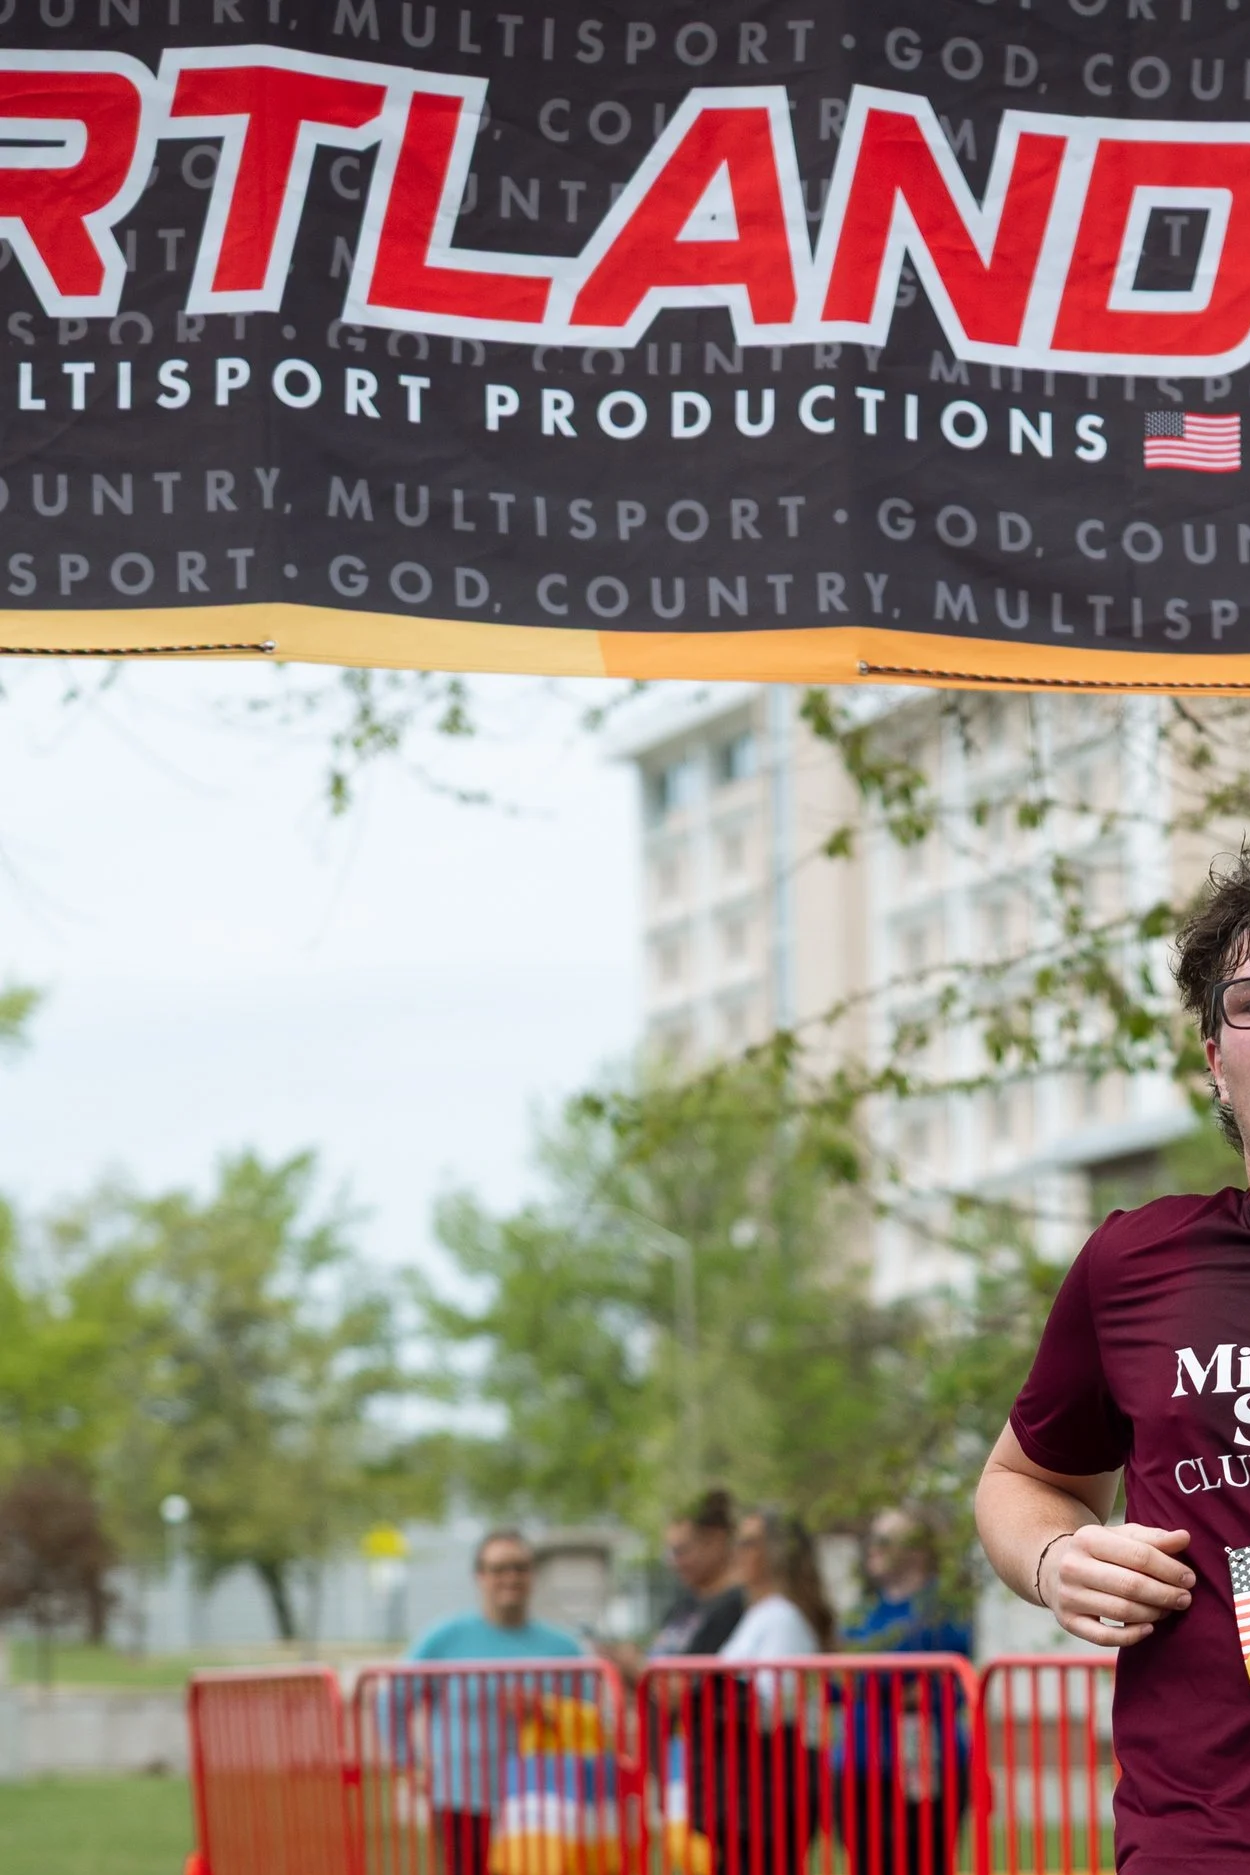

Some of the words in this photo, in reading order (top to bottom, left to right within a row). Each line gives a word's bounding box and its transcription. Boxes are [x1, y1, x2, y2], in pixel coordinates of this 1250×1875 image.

[333, 0, 815, 66] MULTISPORT
[885, 27, 1048, 94] GOD,
[18, 357, 431, 424] LTISPORT
[484, 383, 1108, 463] PRODUCTIONS
[0, 468, 292, 516] UNTRY,
[327, 475, 806, 542] MULTISPORT
[877, 496, 1045, 558] GOD,
[8, 548, 255, 596] SPORT
[328, 554, 501, 614] GOD,
[536, 571, 900, 619] COUNTRY,
